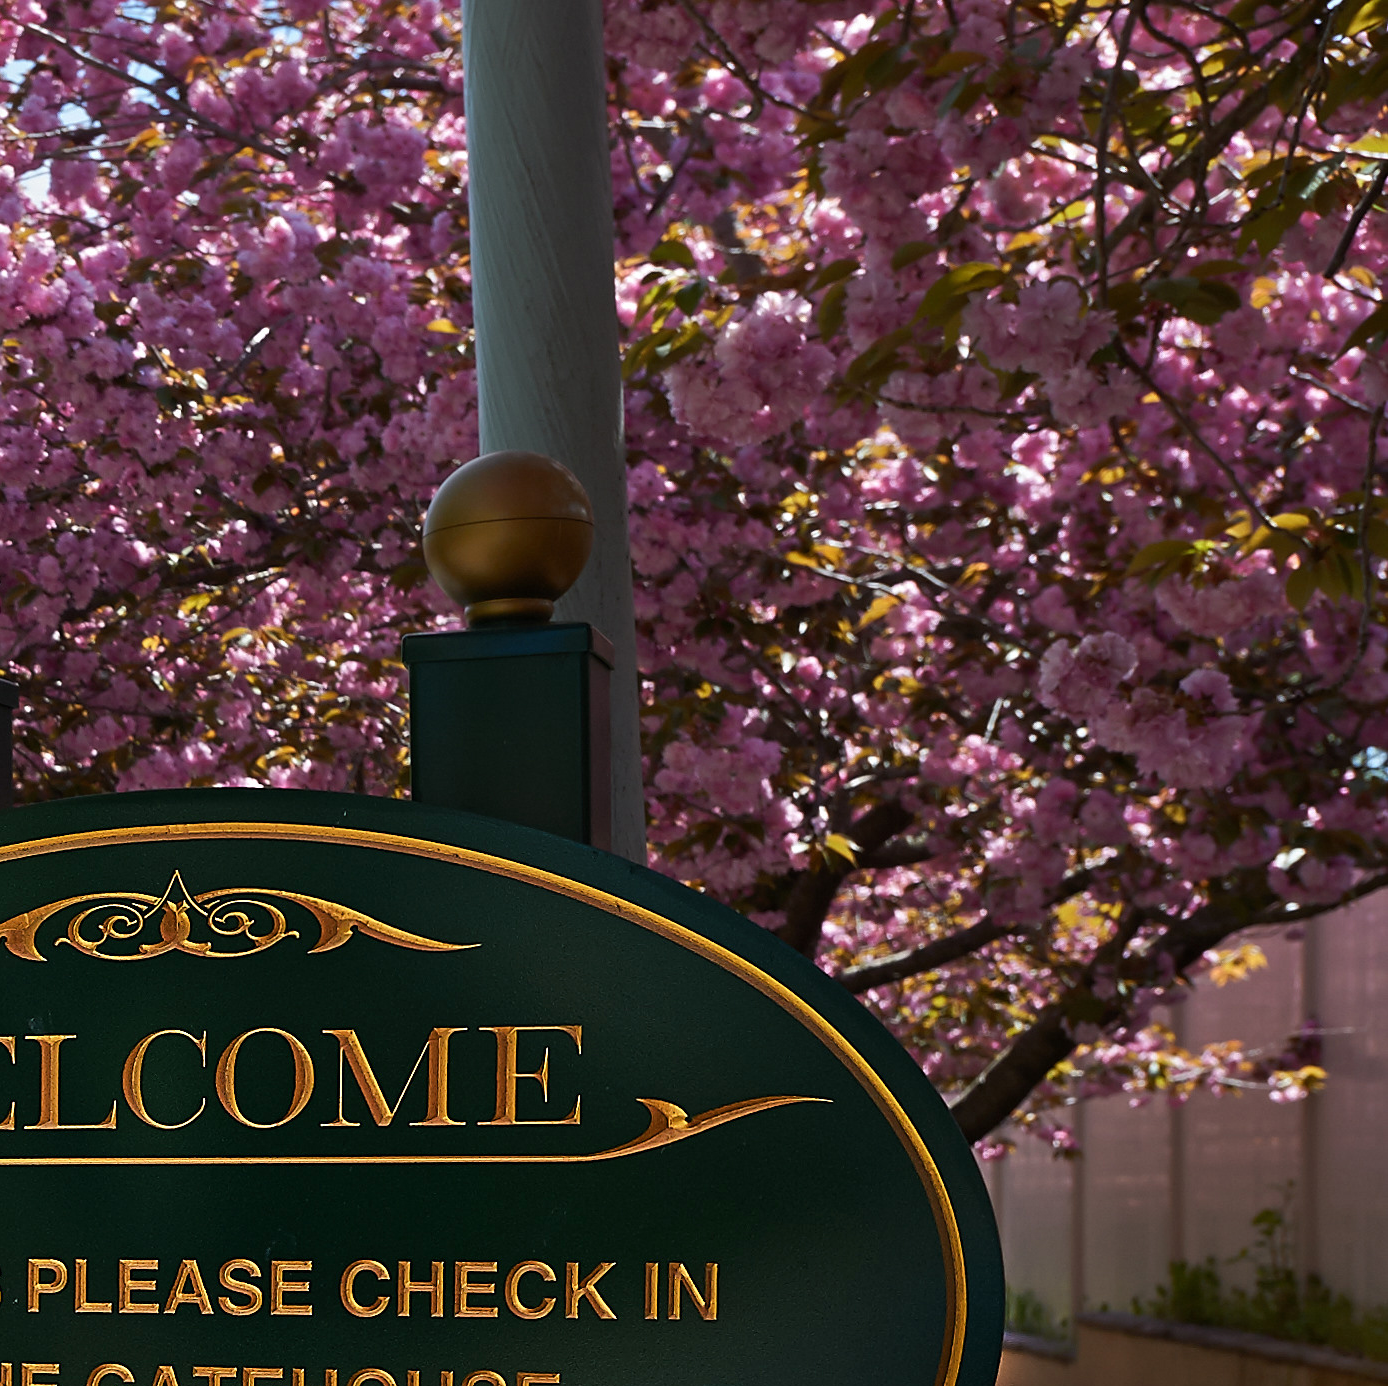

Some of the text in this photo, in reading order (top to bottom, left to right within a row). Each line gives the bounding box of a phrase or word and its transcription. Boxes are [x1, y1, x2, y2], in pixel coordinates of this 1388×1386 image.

[28, 1259, 314, 1318] PLEASE
[339, 1260, 617, 1320] CHECK
[643, 1263, 720, 1322] IN
